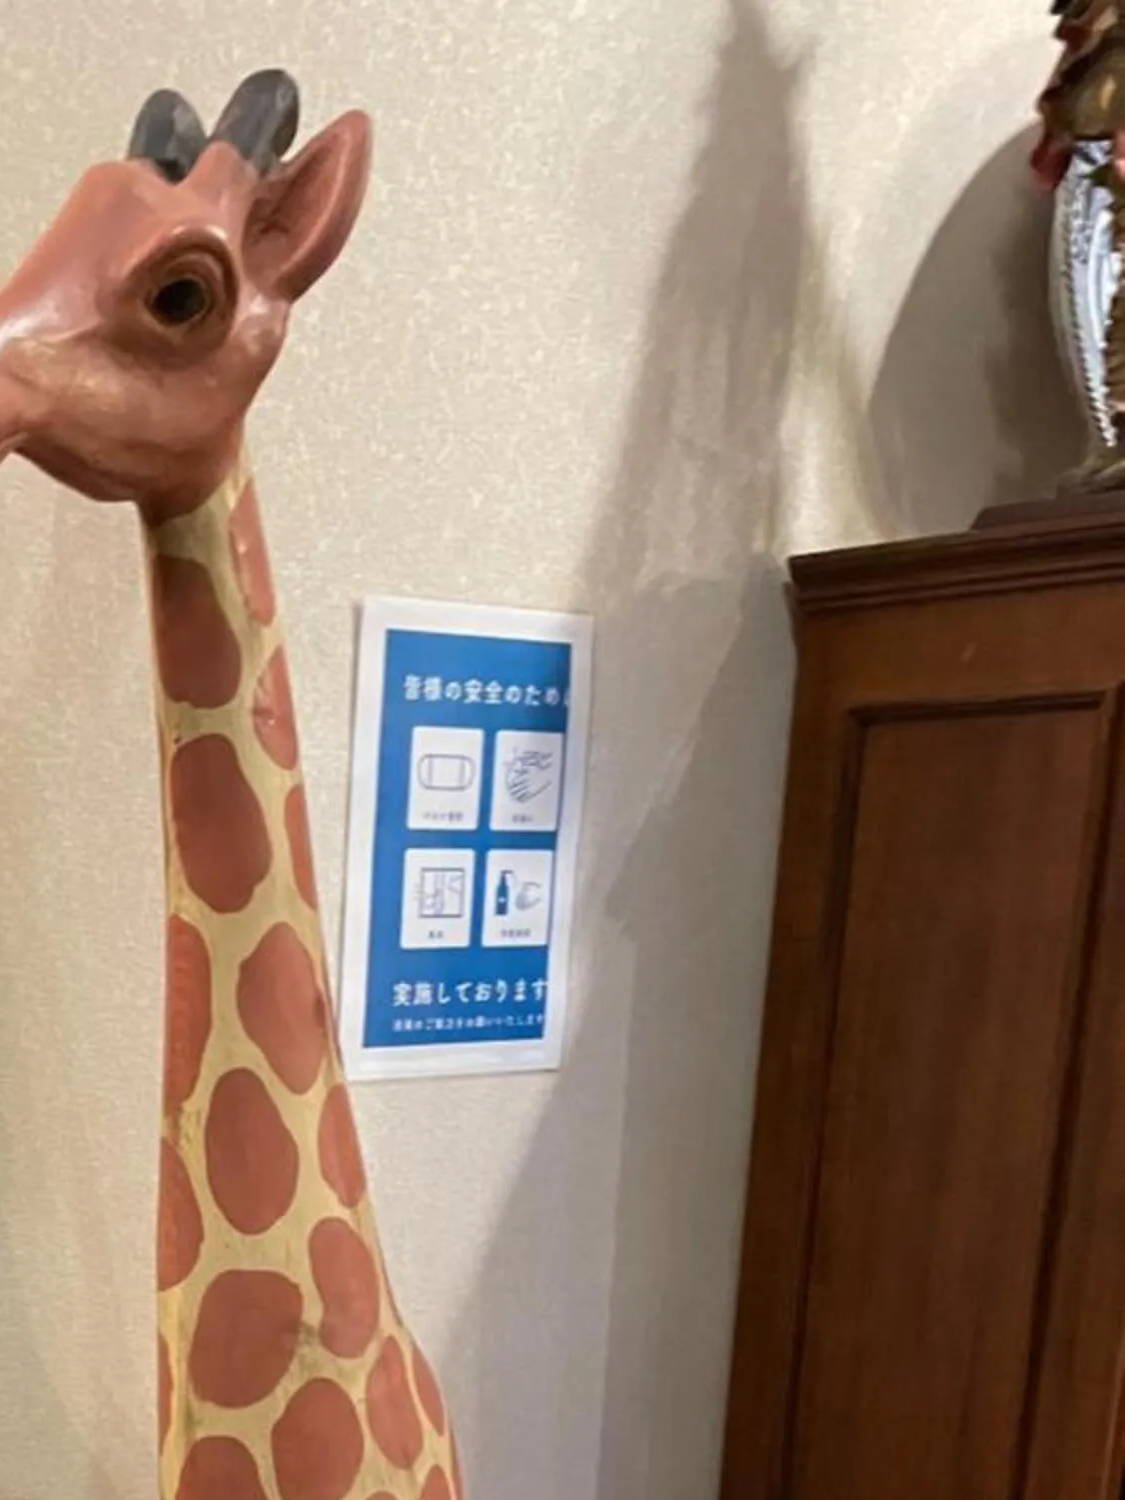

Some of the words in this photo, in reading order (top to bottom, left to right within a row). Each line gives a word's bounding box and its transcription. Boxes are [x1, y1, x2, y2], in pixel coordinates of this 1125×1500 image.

[393, 976, 548, 1007] 実施しております
